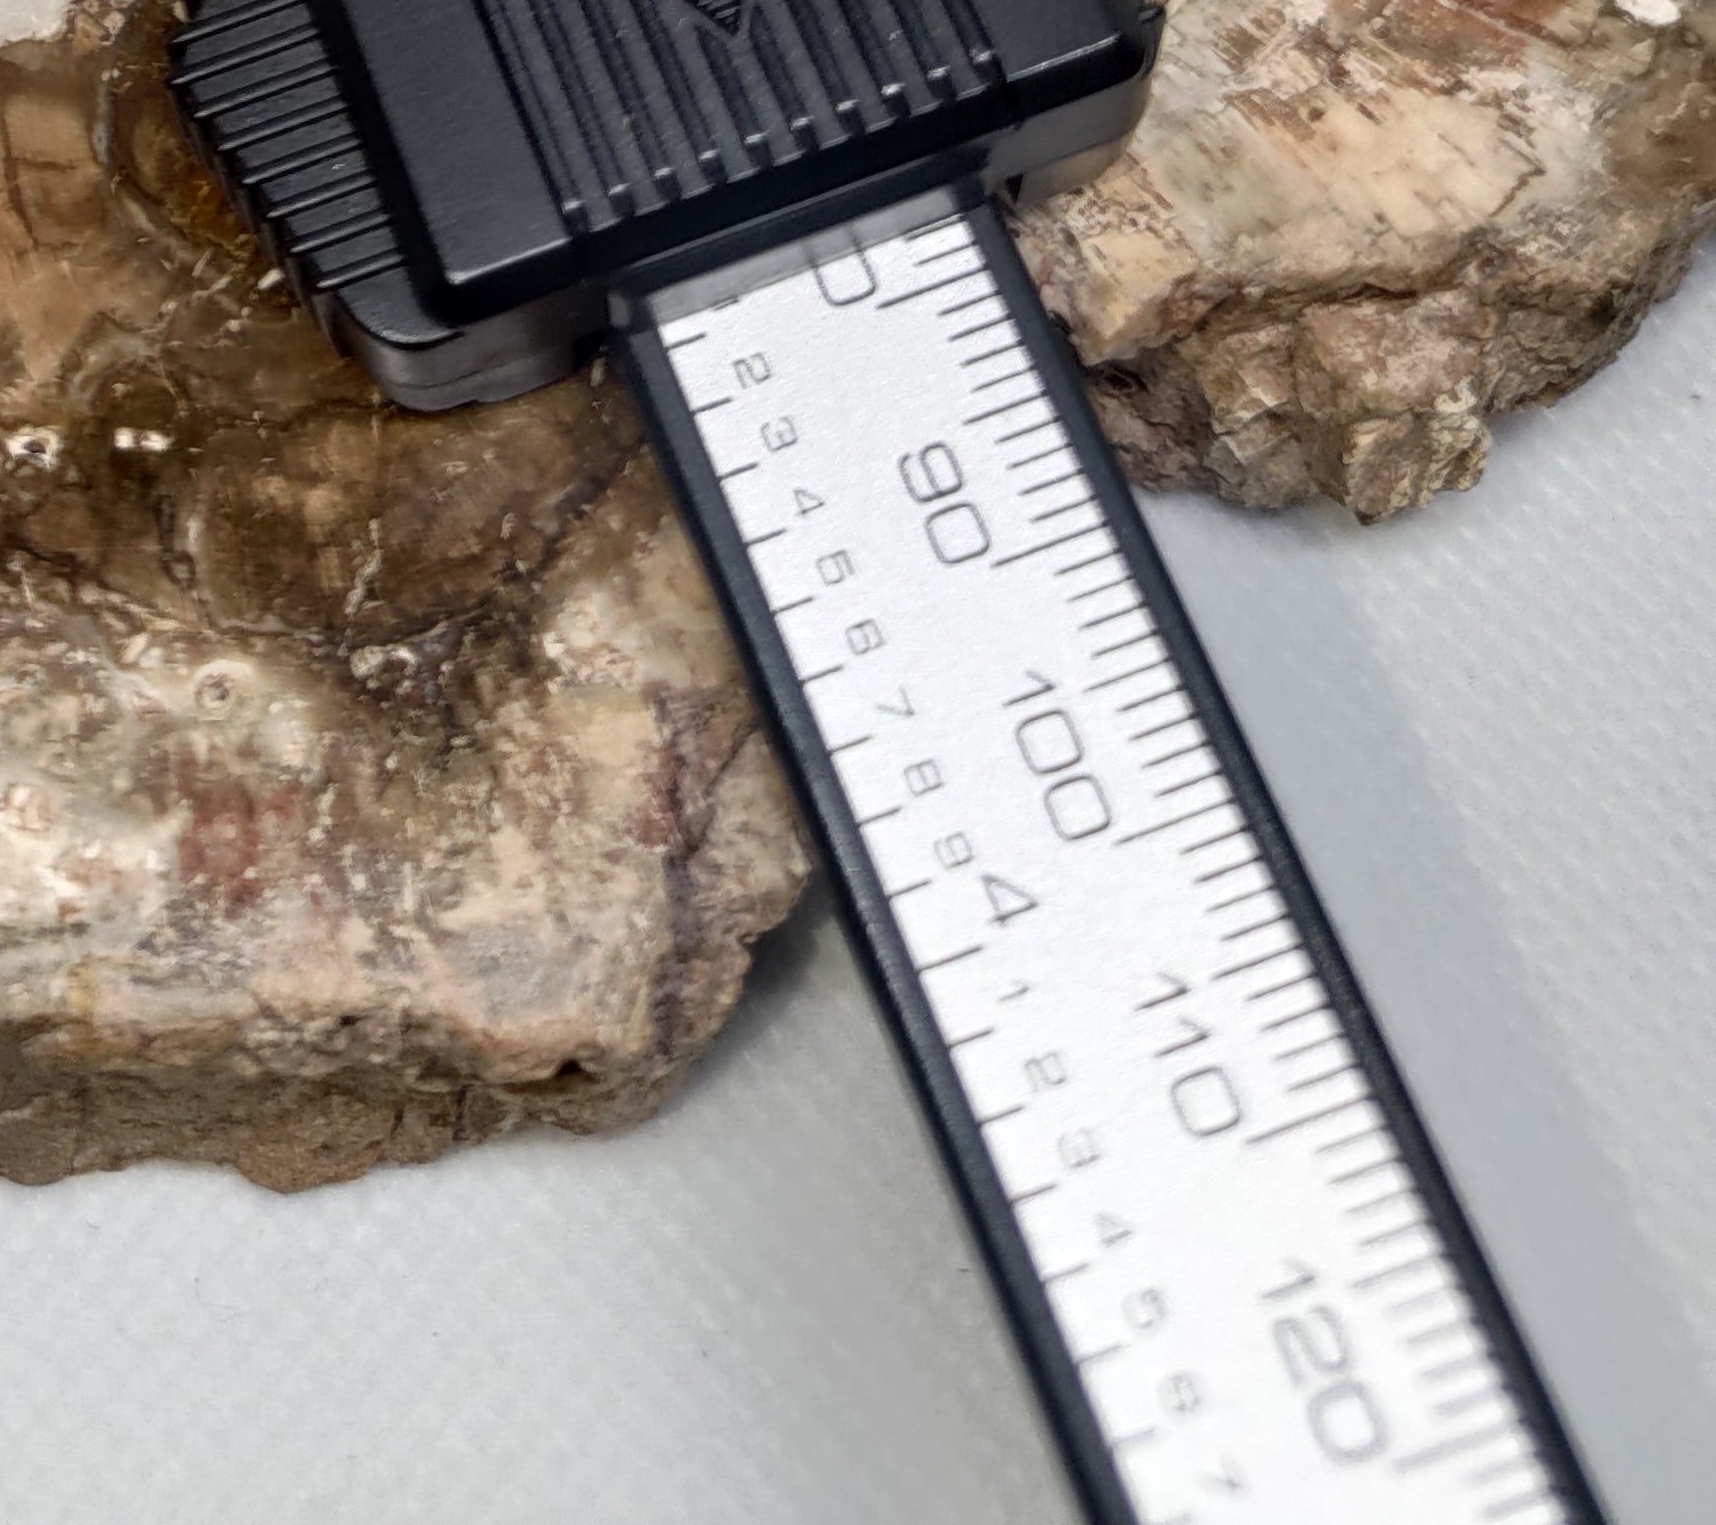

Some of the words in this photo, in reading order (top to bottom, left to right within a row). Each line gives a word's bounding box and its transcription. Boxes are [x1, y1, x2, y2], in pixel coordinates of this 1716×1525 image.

[733, 352, 772, 390] 2
[761, 416, 798, 452] 3
[792, 486, 825, 517] 4
[816, 550, 855, 586] 5
[845, 618, 885, 655] 6
[876, 686, 914, 718] 7
[903, 759, 945, 797] 8
[933, 830, 973, 870] 9
[981, 873, 1038, 927] 4
[898, 441, 990, 564] 90
[1002, 670, 1113, 840] 100
[1134, 970, 1240, 1136] 110
[1260, 1257, 1387, 1463] 120
[998, 979, 1030, 1002] 1
[1024, 1052, 1067, 1092] 2
